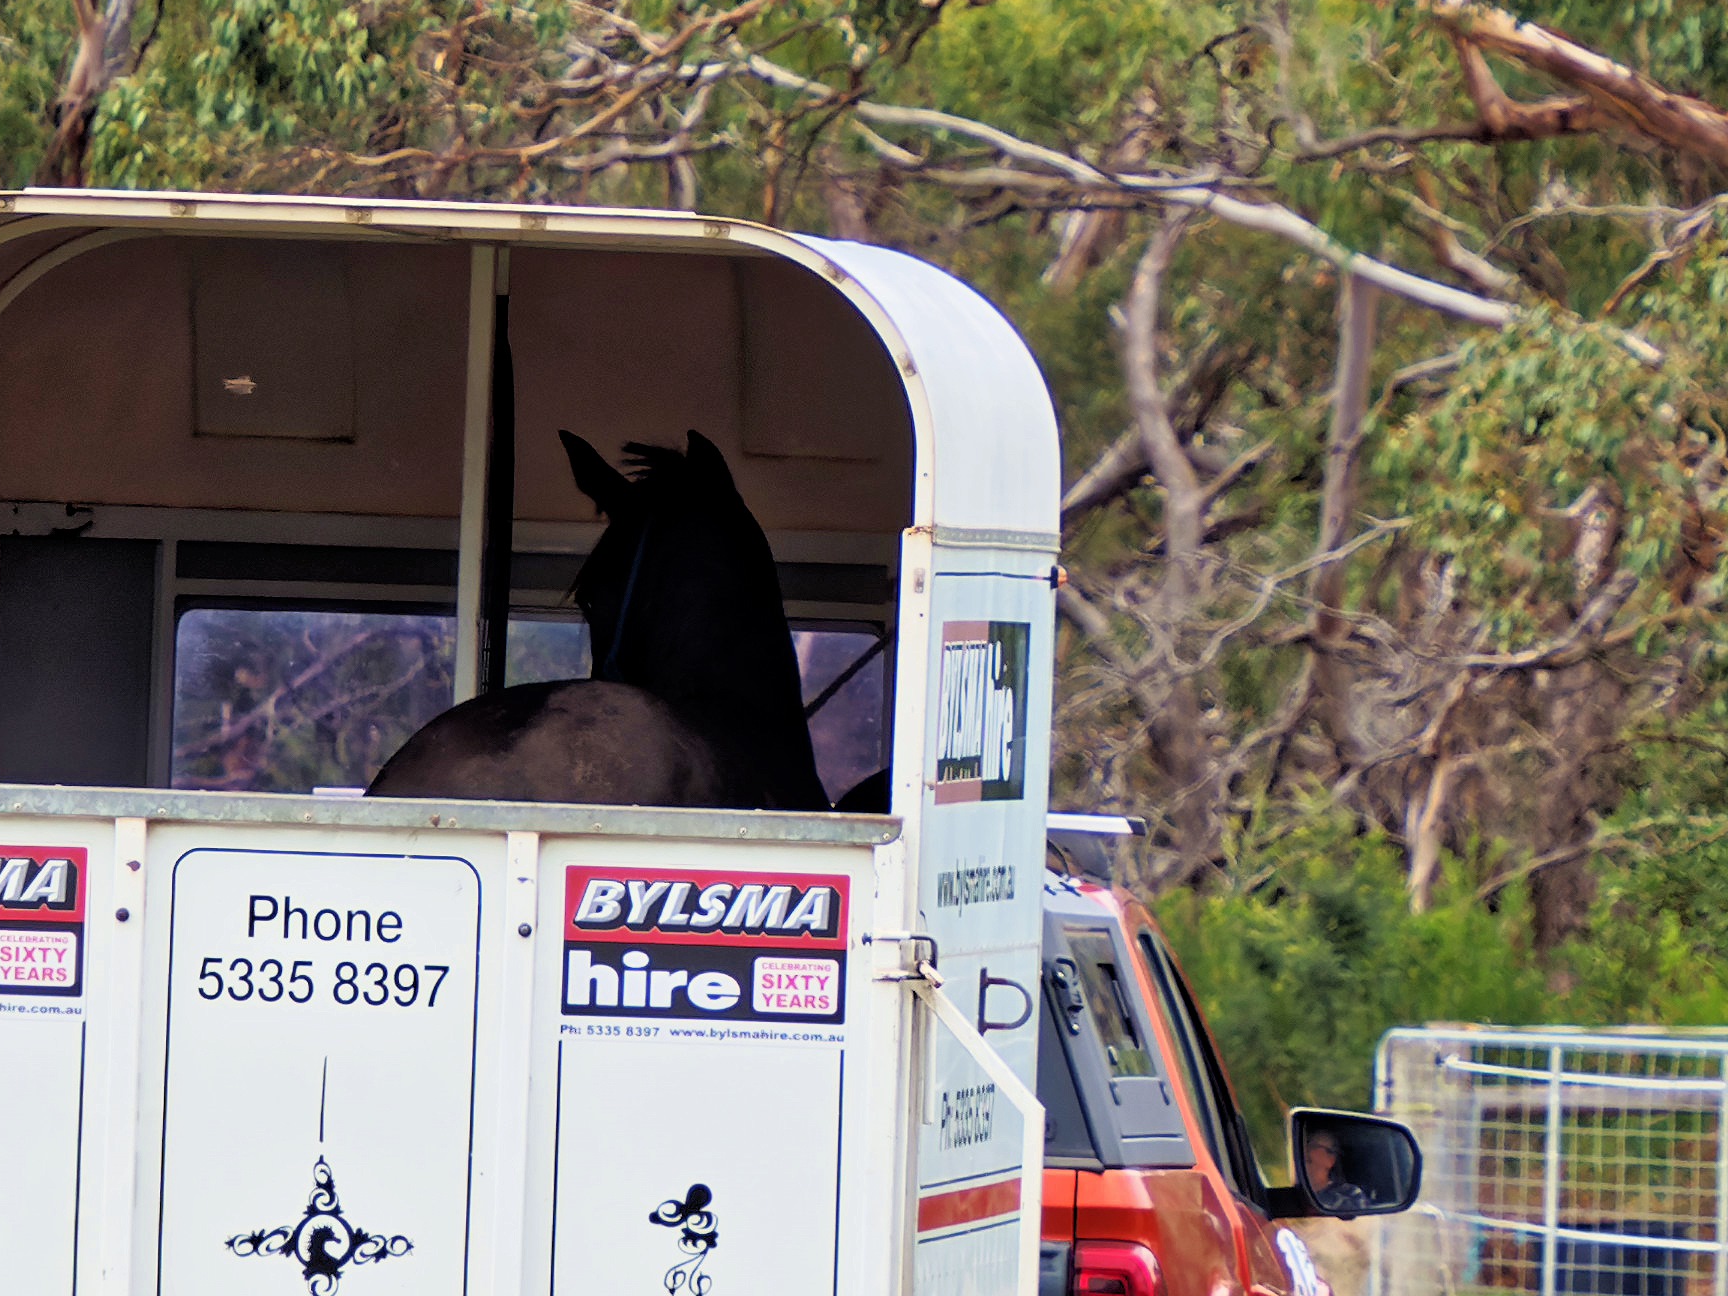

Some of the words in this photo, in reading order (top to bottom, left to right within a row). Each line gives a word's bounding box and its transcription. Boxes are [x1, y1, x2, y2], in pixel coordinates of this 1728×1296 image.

[982, 641, 1013, 781] hire
[574, 878, 839, 938] BYLSMA
[248, 895, 403, 943] Phone
[0, 934, 69, 944] CELEBRATING
[0, 946, 68, 963] SIXTY
[0, 966, 68, 982] YEARS
[761, 962, 832, 972] CELEBRATING
[198, 957, 315, 1003] 5335
[332, 961, 450, 1007] 8397
[567, 949, 741, 1010] hire
[762, 974, 830, 991] SIXTY
[762, 993, 830, 1009] YEARS
[560, 1024, 582, 1036] Ph:
[587, 1025, 621, 1037] 5335
[626, 1026, 660, 1038] 8397
[669, 1028, 845, 1044] www.bylsmahire.com.au
